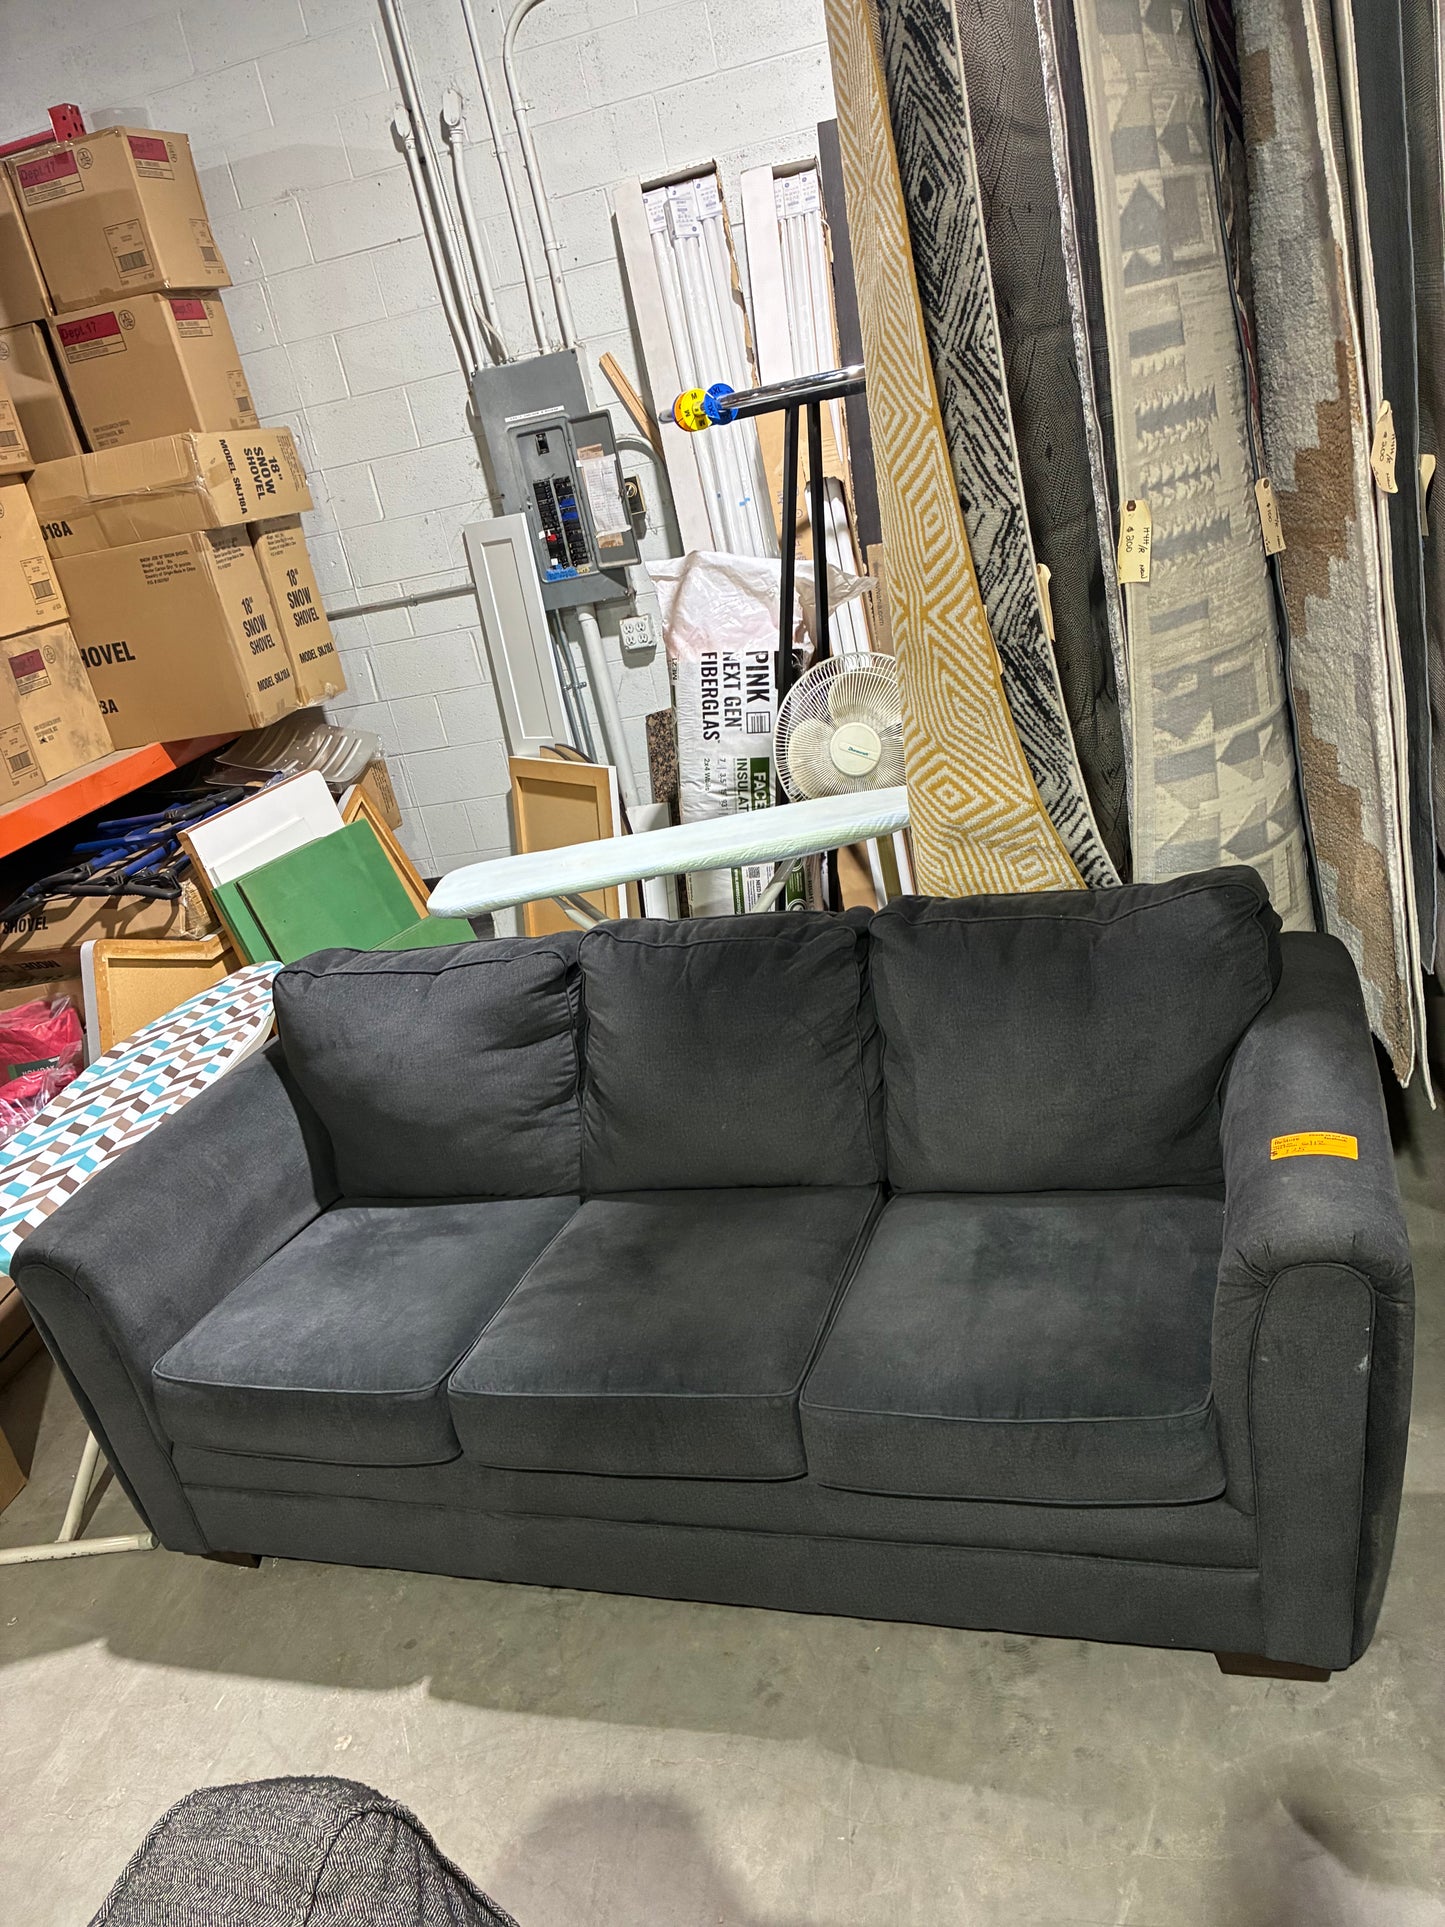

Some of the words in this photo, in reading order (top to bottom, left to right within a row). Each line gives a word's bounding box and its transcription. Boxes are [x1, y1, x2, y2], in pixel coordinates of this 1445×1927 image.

[219, 439, 236, 474] MODEL
[233, 477, 248, 514] SNJ18A
[244, 448, 265, 500] SHOVEL
[253, 446, 276, 494] SNOW
[286, 568, 299, 587] 18"
[241, 596, 254, 615] 18"
[286, 586, 312, 610] SNOW
[242, 613, 268, 638] SNOW
[293, 607, 320, 627] SHOVEL
[249, 633, 276, 655] SHOVEL
[299, 648, 318, 664] MODEL
[257, 675, 275, 692] MODEL
[722, 651, 741, 690] NEXT
[745, 650, 770, 703] PINK
[700, 651, 720, 741] FIBERGLAS
[723, 696, 742, 728] GEN
[736, 758, 749, 812] INSULAT
